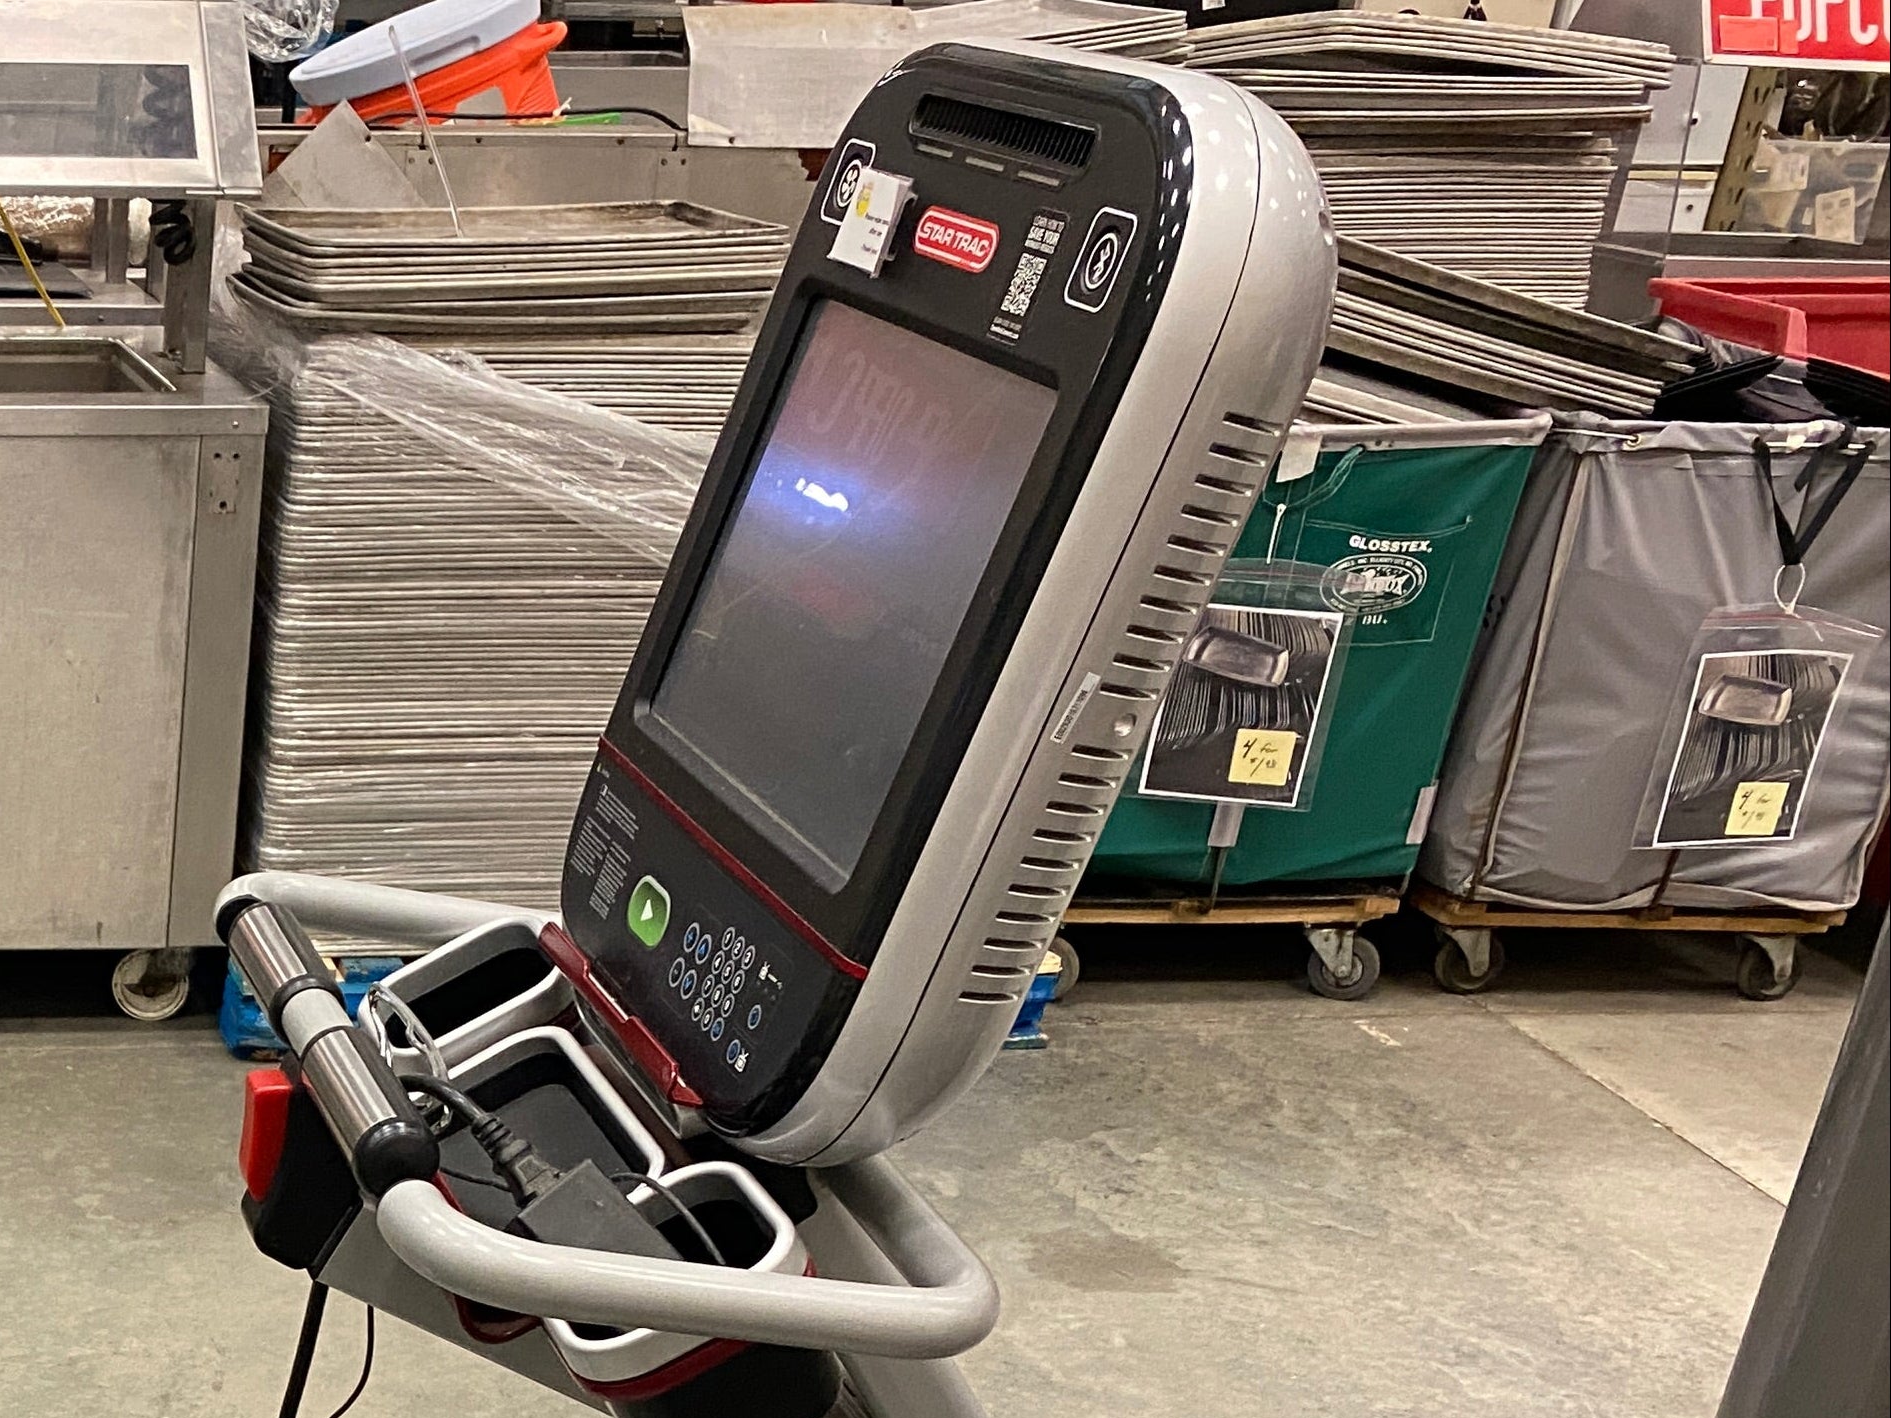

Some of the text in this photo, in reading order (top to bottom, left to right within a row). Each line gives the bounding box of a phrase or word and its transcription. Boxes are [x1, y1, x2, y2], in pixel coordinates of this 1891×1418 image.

[919, 222, 991, 257] STAR TRAC
[1243, 738, 1258, 759] 4
[1739, 789, 1754, 810] 4
